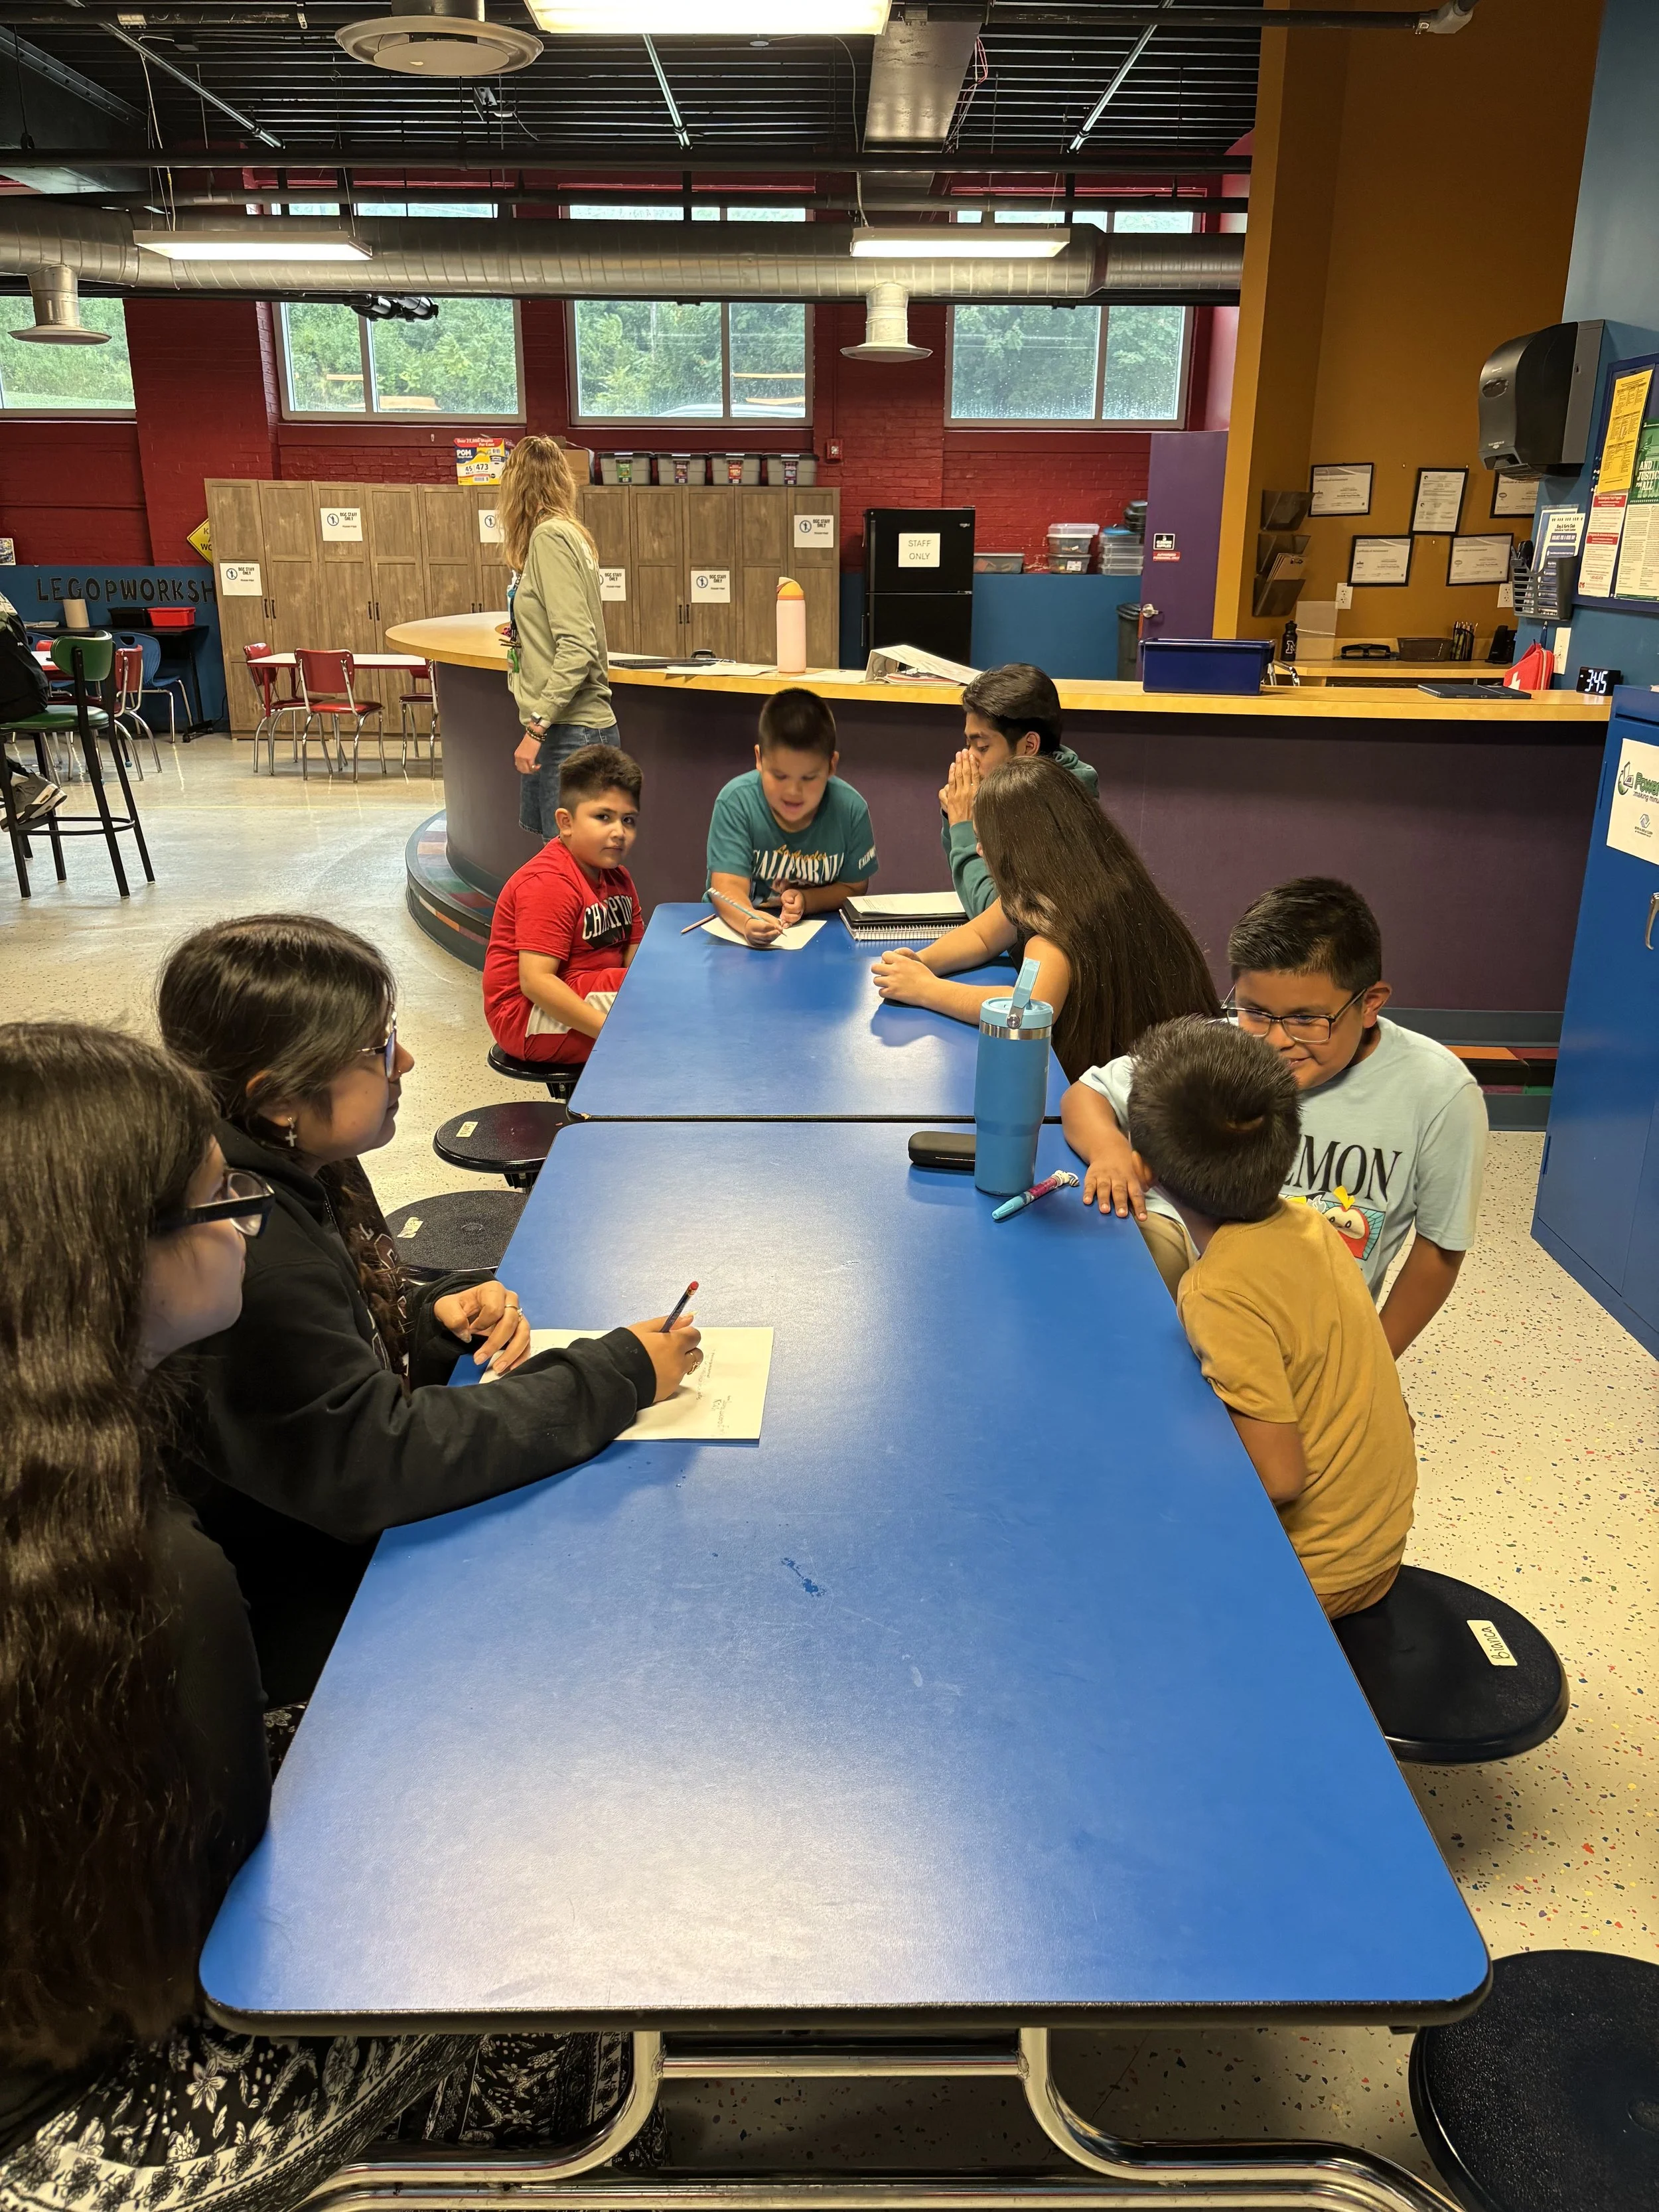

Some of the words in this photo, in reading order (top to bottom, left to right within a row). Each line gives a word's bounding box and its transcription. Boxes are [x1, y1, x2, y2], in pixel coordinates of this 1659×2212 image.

[1639, 461, 1652, 470] AND
[1642, 481, 1653, 490] ALL
[1584, 669, 1609, 694] 3:45
[1283, 1134, 1403, 1203] MON
[1481, 1626, 1511, 1659] Bianca
